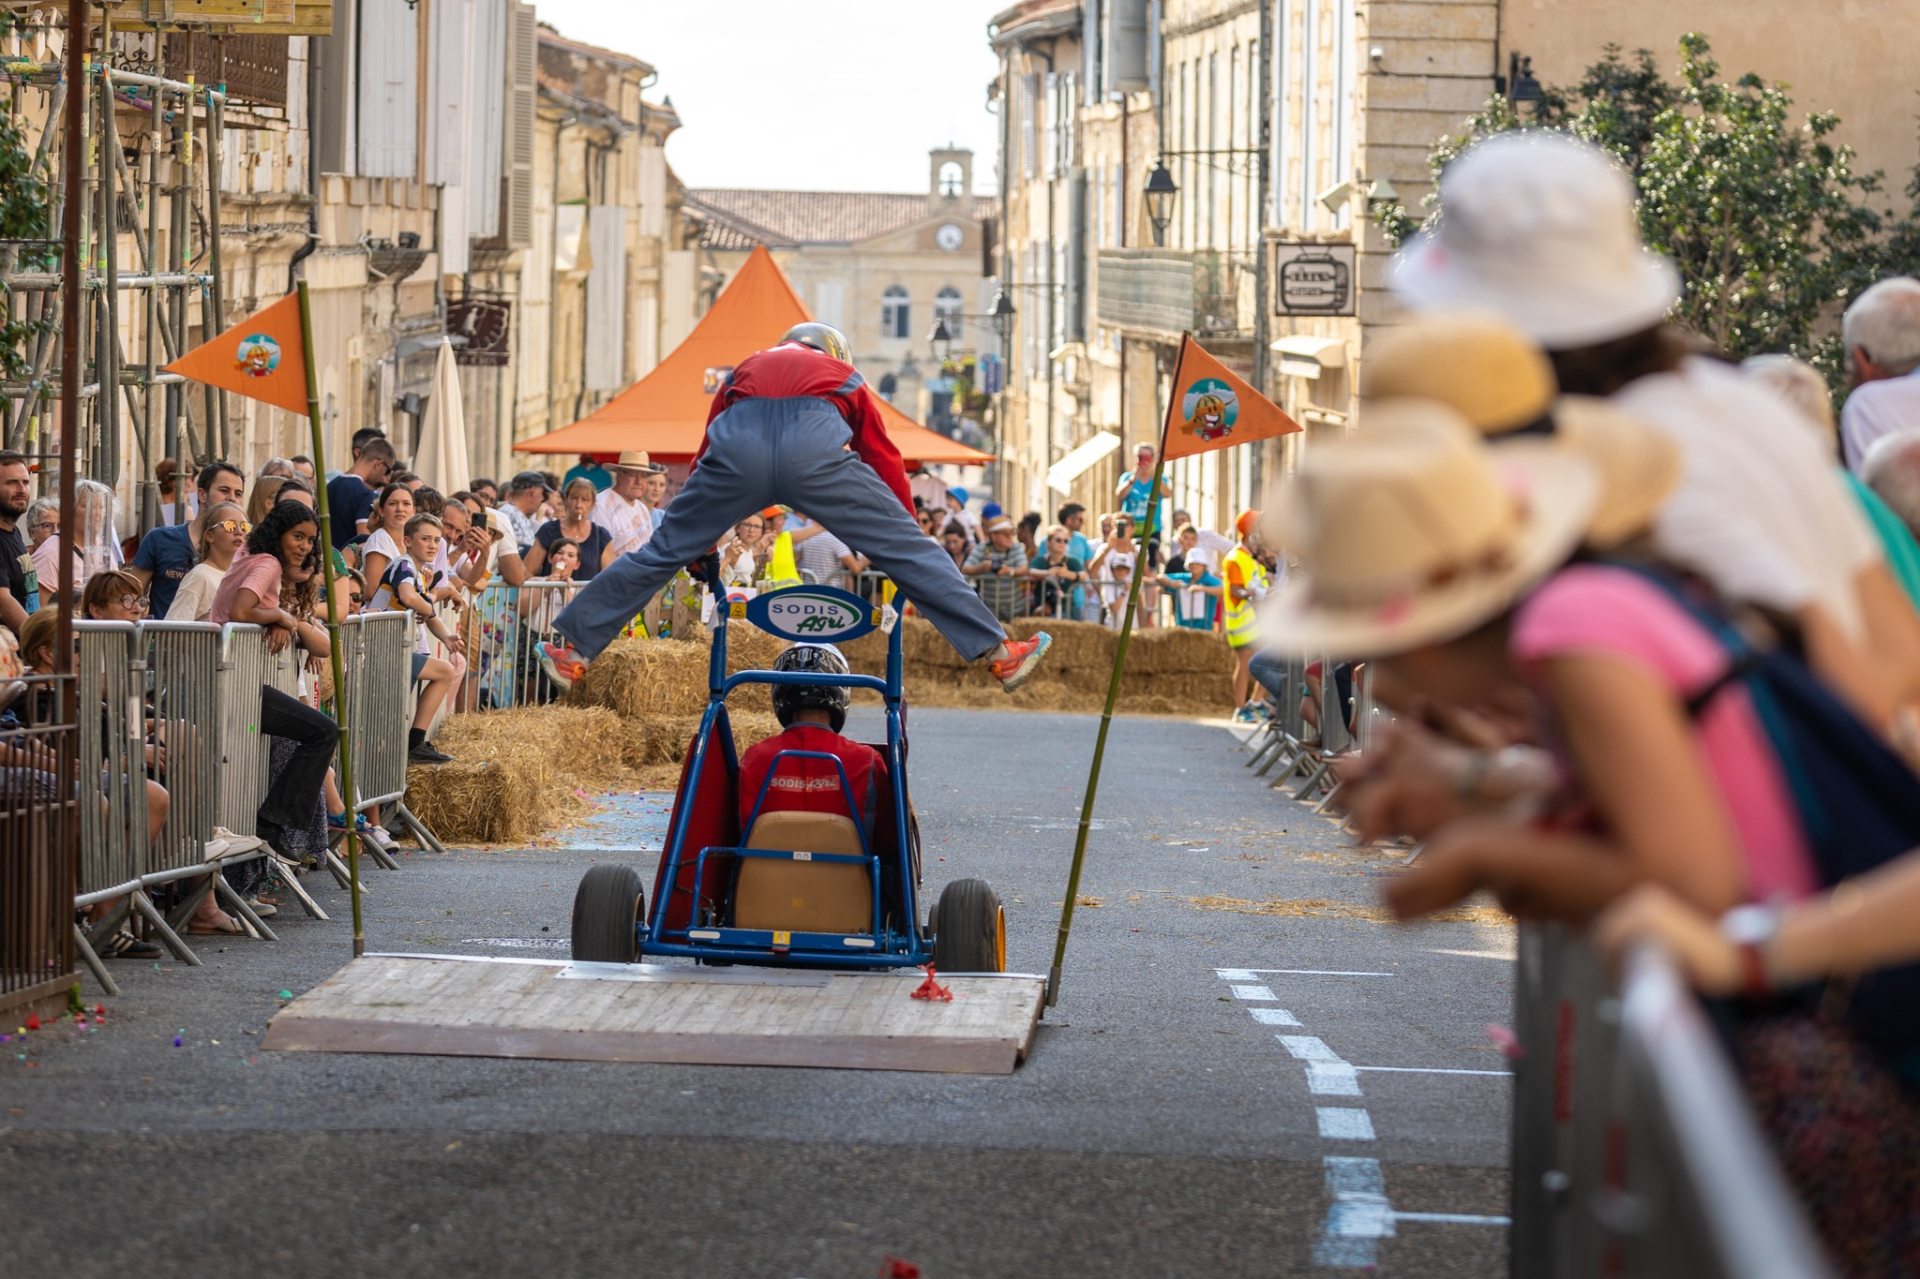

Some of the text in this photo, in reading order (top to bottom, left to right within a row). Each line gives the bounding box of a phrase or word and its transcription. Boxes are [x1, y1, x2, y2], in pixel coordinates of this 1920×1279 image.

[165, 570, 184, 579] NEW
[772, 604, 839, 615] SODIS
[796, 615, 845, 633] Agri
[770, 777, 805, 788] SODIS
